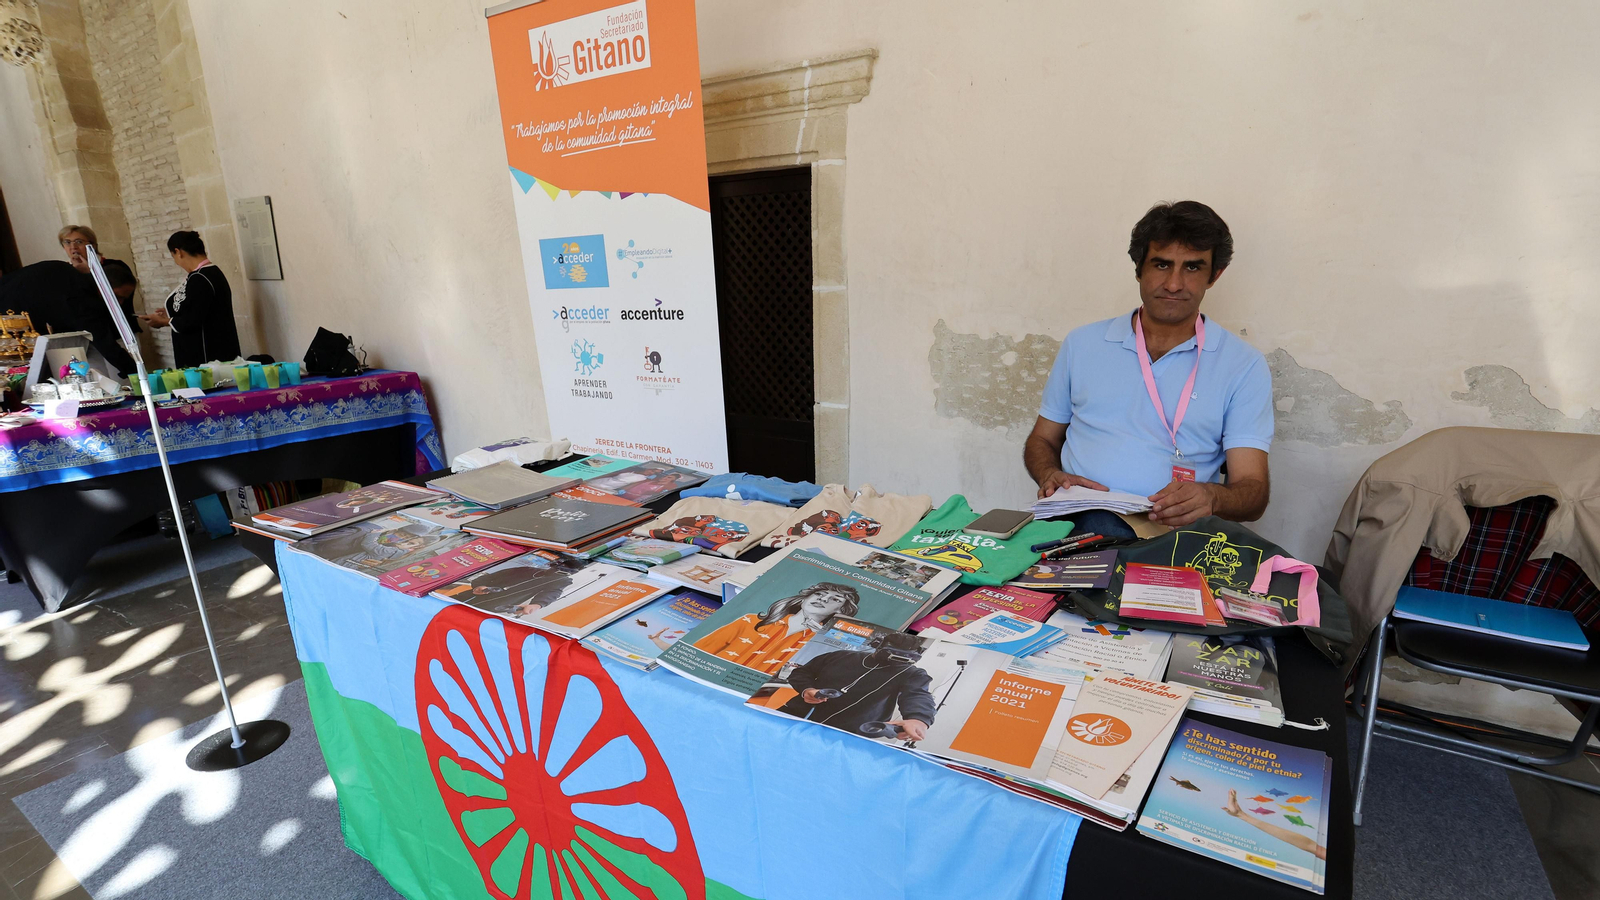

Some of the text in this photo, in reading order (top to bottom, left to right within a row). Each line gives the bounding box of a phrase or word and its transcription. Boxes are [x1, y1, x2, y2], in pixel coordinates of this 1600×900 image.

[606, 9, 643, 26] Fundación
[600, 20, 644, 39] Secretariado
[573, 35, 646, 75] Gitano
[567, 112, 584, 134] por
[586, 110, 596, 126] la
[597, 102, 648, 129] promoción
[650, 91, 693, 118] integral
[542, 138, 554, 153] de
[555, 136, 565, 150] la
[566, 126, 616, 148] comunidad
[620, 308, 684, 320] accenture
[574, 379, 607, 388] APRENDER
[571, 389, 613, 400] TRABAJANDO
[595, 438, 614, 447] JEREZ
[616, 440, 625, 448] DE
[635, 443, 672, 454] FRONTERA
[695, 460, 714, 470] 11403
[792, 553, 844, 574] Discriminación
[852, 572, 896, 591] Comunidad
[897, 588, 923, 600] Gitana
[979, 588, 1014, 602] FERIA
[847, 626, 870, 636] Gitano
[1099, 640, 1136, 650] Asistencia
[1187, 641, 1260, 660] AVAN
[1196, 650, 1251, 668] ZAR
[1199, 661, 1226, 670] ESTÁ
[1193, 664, 1251, 679] NUESTRAS
[1201, 671, 1242, 682] MANOS
[994, 686, 1033, 700] anual
[999, 678, 1052, 696] Informe
[990, 694, 1026, 709] 2021
[1188, 737, 1281, 768] discriminado/a por tu
[1205, 733, 1227, 746] has
[1229, 742, 1277, 760] sentido
[1188, 758, 1213, 770] apoyamos
[1219, 768, 1250, 780] asesoramos
[1215, 752, 1235, 763] color
[1249, 762, 1265, 772] piel
[1274, 768, 1302, 779] etnia?
[1159, 809, 1181, 820] SERVICIO
[1189, 820, 1218, 833] ASISTENCIA
[1222, 831, 1257, 845] ORIENTACIÓN
[1192, 826, 1233, 843] DISCRIMINACIÓN
[1234, 841, 1252, 850] RACIAL
